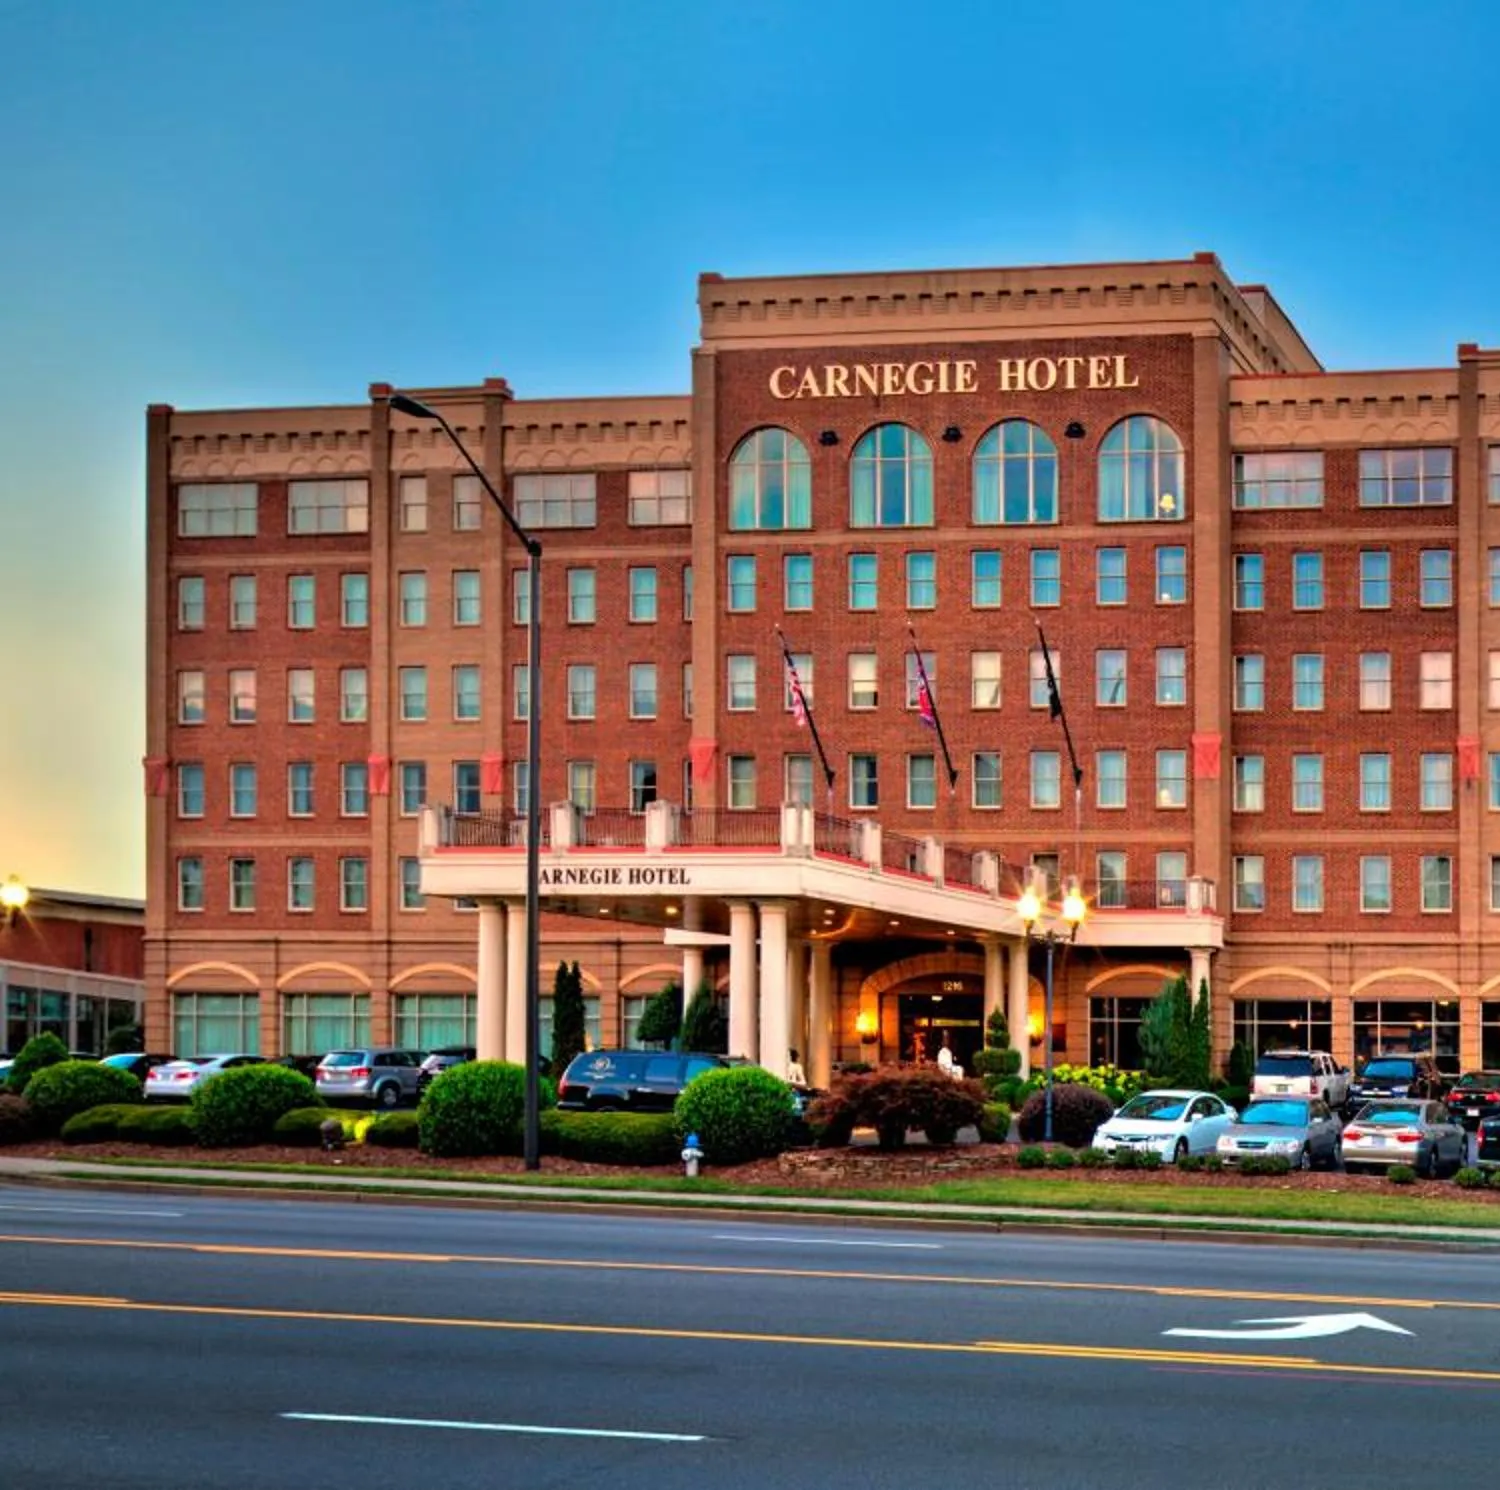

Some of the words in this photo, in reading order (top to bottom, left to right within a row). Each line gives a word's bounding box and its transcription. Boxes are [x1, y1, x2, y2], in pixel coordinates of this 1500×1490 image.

[769, 360, 977, 399] CARNEGIE
[999, 355, 1139, 391] HOTEL
[531, 867, 622, 885] ARNEGIE
[628, 867, 691, 885] HOTEL
